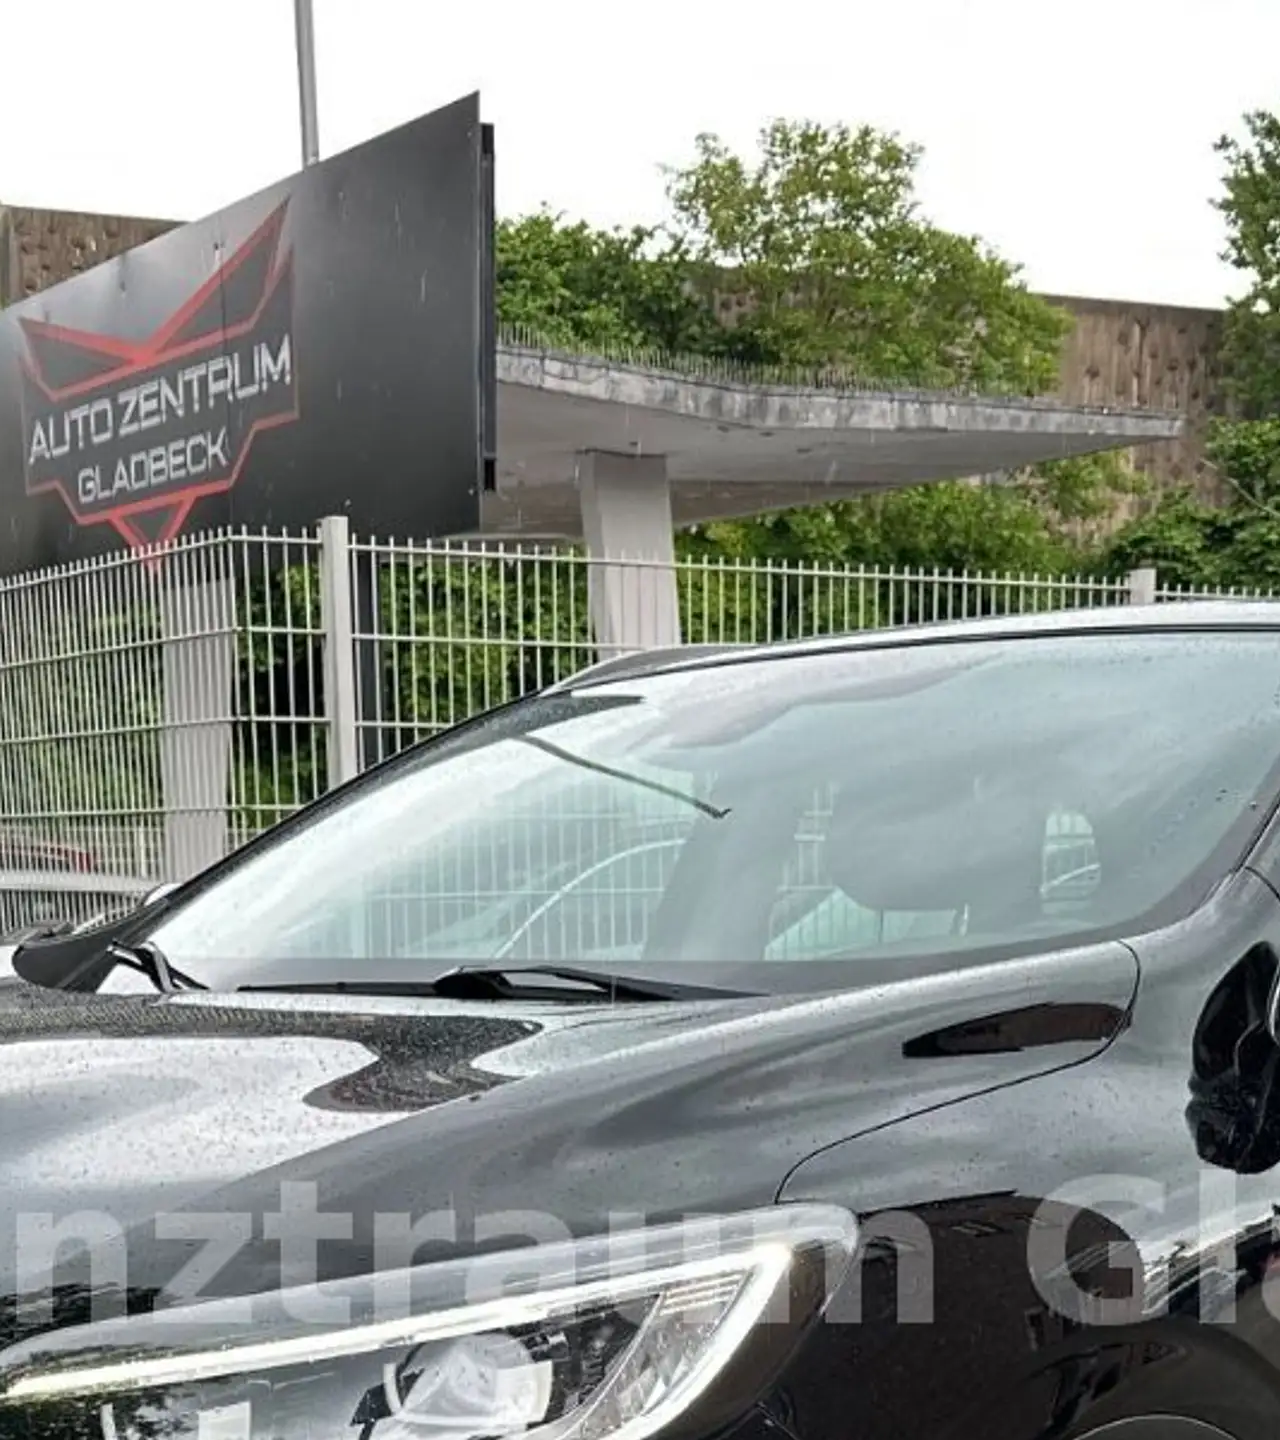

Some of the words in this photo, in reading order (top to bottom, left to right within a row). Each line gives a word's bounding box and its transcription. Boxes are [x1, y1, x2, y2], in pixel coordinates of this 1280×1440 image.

[28, 397, 114, 466] AUTO
[118, 333, 292, 436] ZENTRUM
[77, 426, 228, 504] GLADBECK
